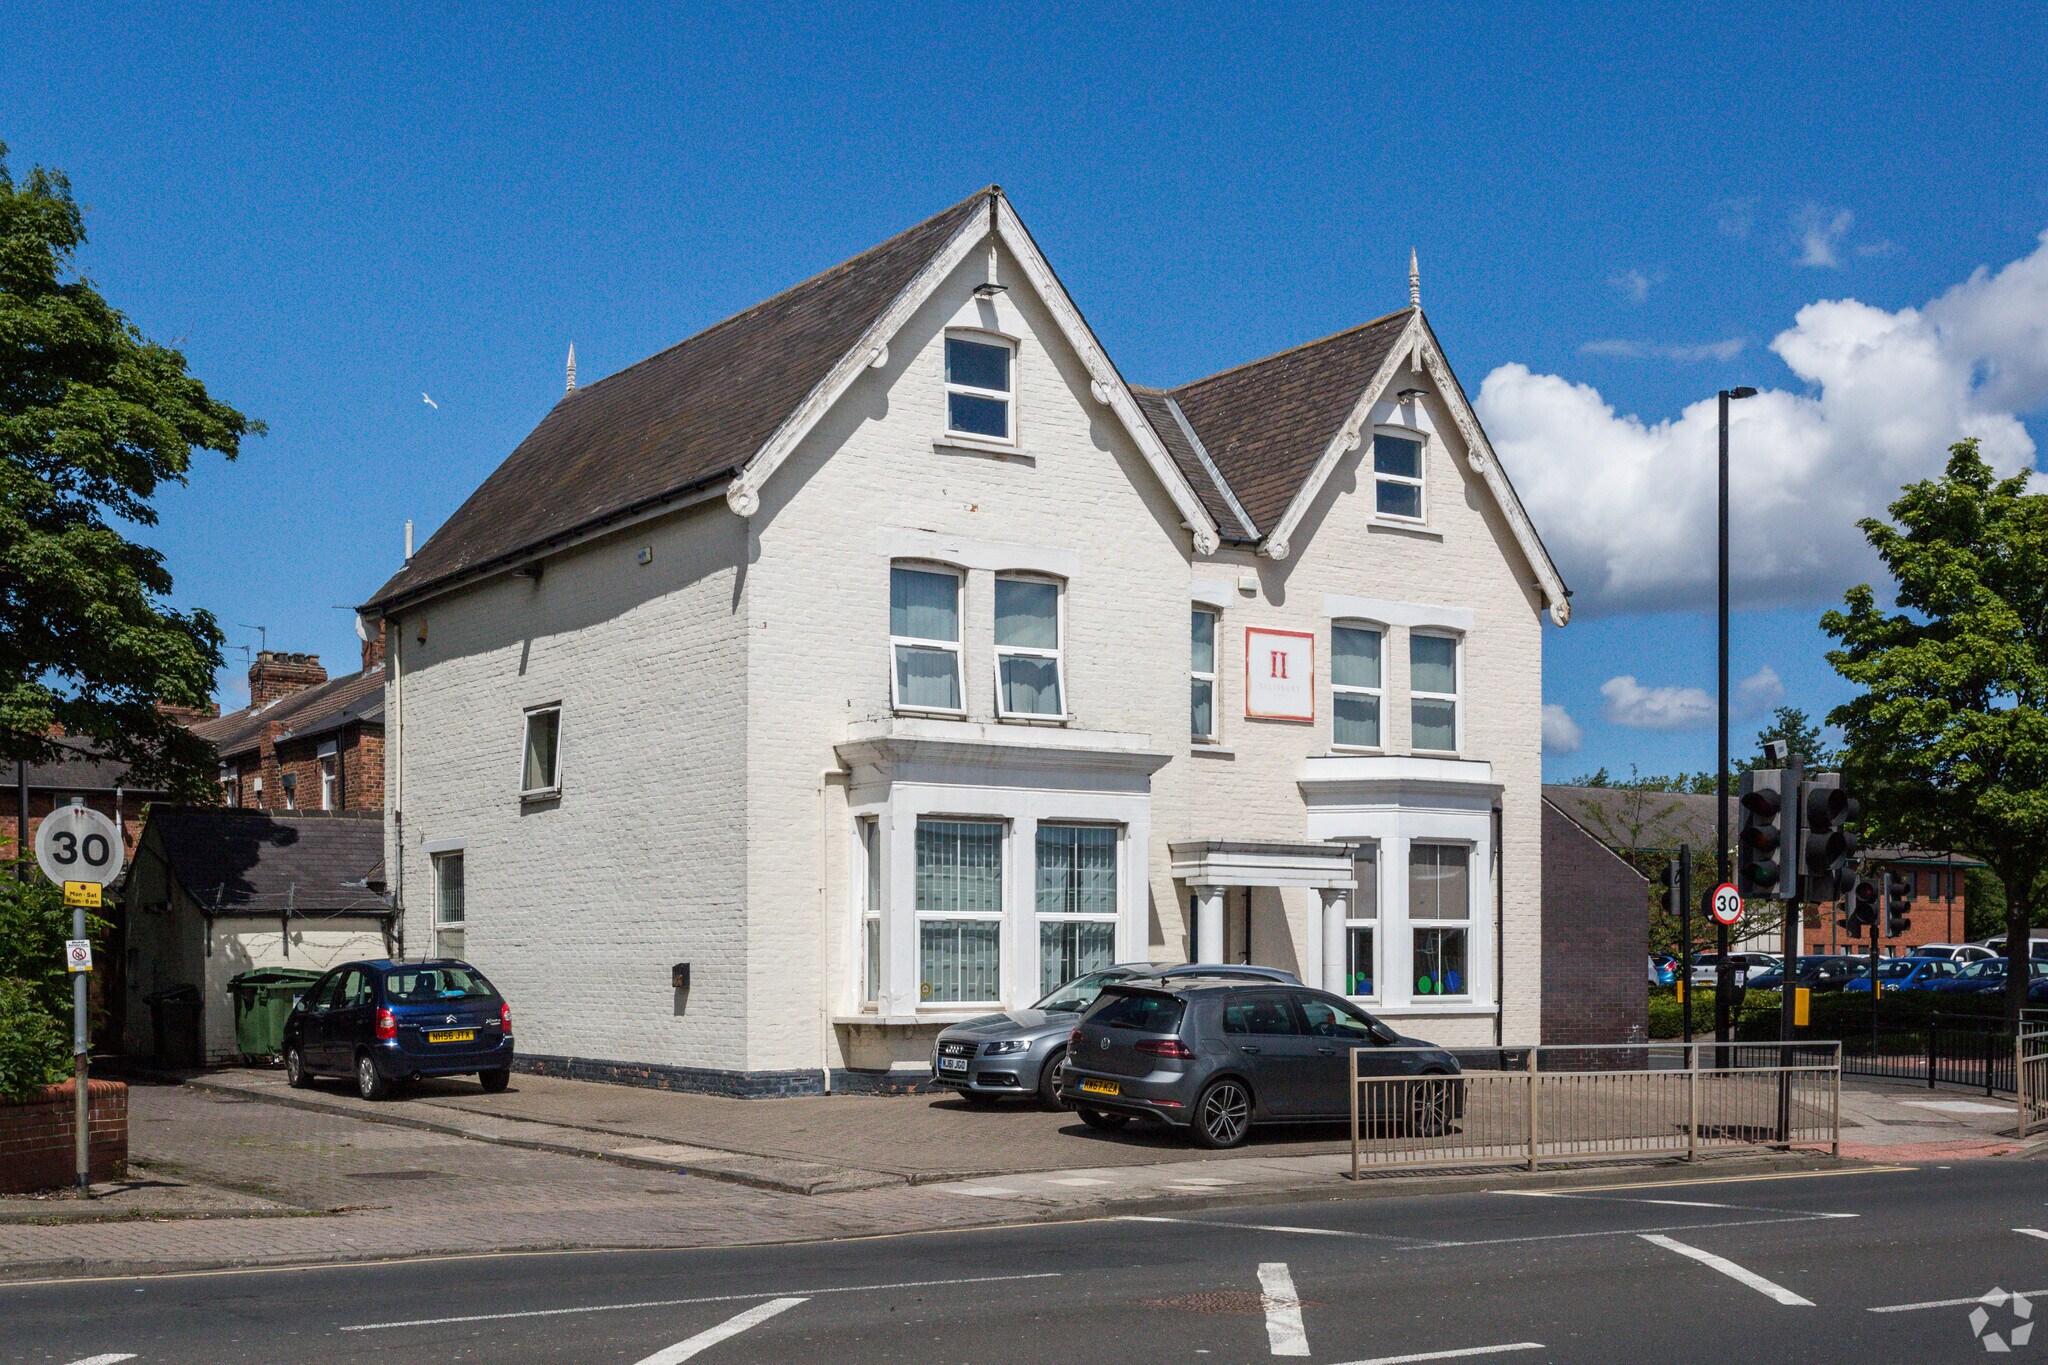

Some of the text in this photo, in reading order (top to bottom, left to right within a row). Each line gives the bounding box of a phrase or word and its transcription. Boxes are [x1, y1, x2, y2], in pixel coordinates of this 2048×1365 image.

[1258, 682, 1301, 693] SALISBURY
[52, 831, 110, 867] 30
[1717, 895, 1739, 912] 30
[432, 1030, 470, 1041] NH56 JTX
